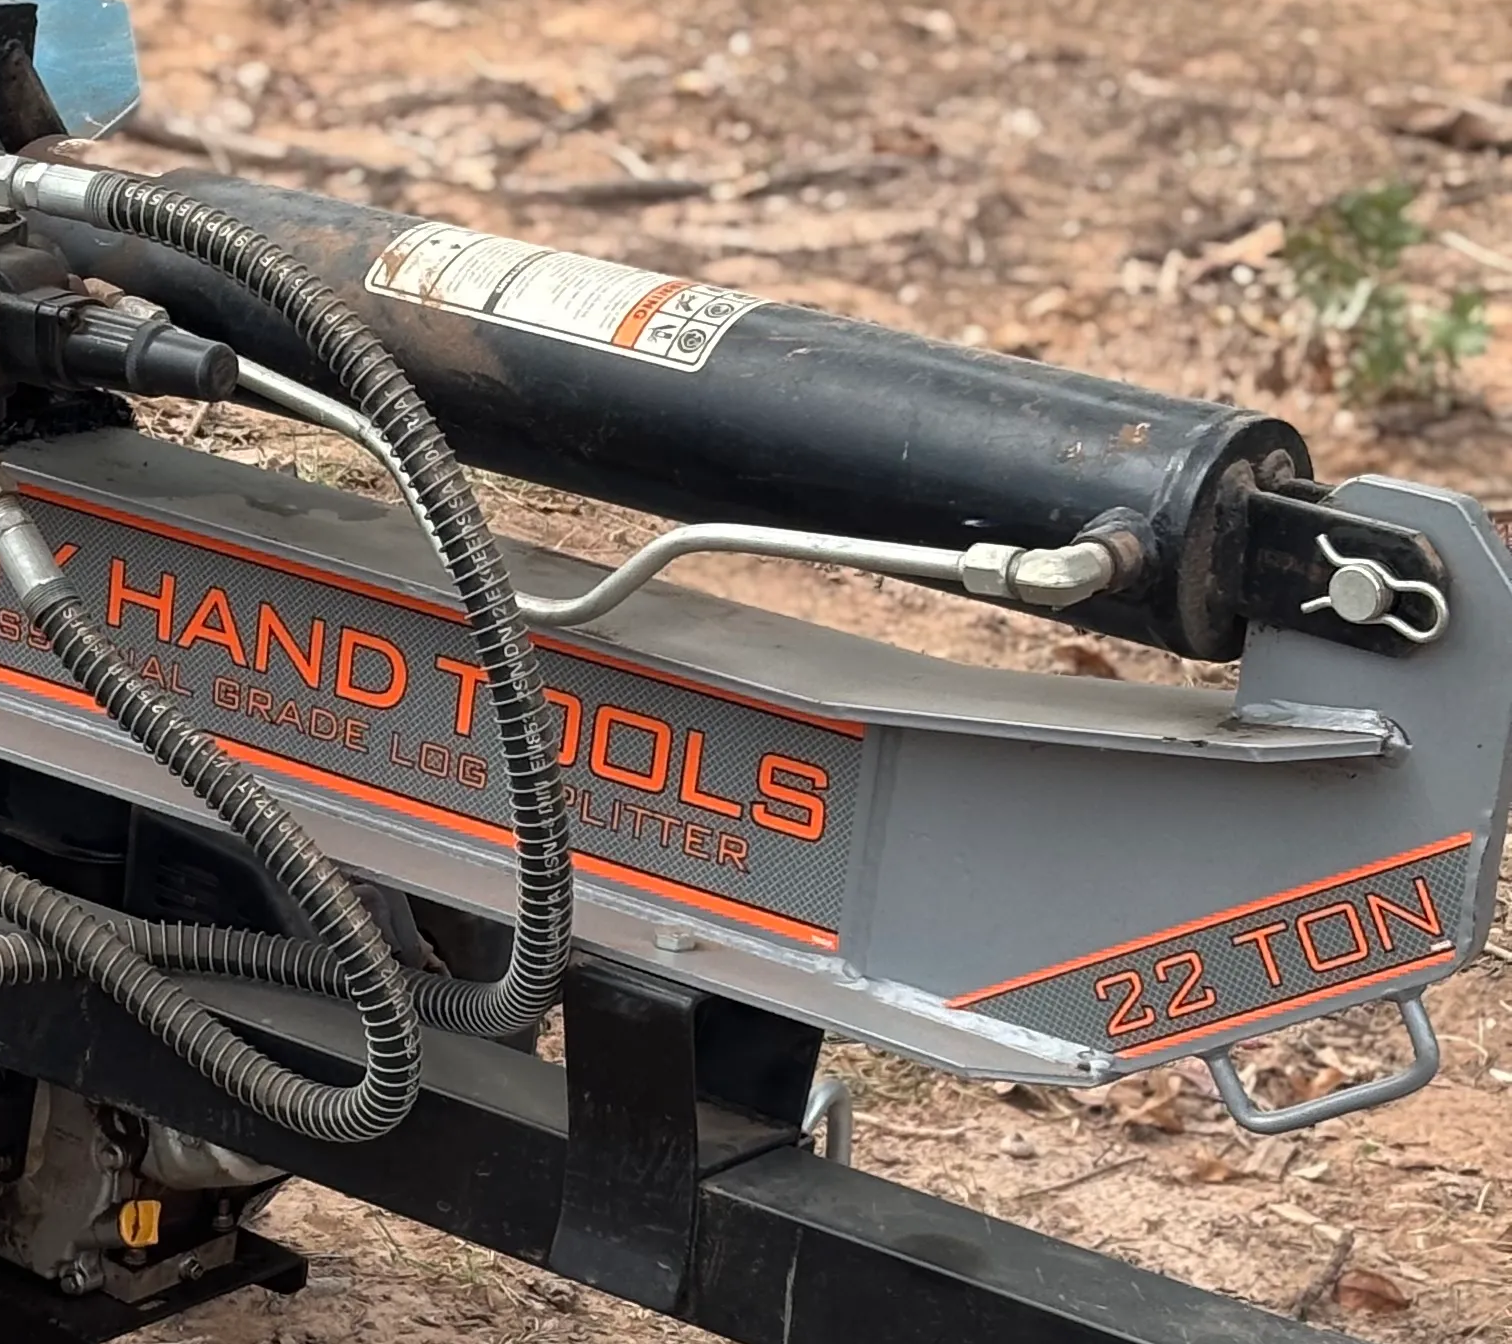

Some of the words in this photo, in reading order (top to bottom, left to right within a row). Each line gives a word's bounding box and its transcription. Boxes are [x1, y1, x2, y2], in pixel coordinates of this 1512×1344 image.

[106, 556, 409, 710] HAND
[435, 655, 830, 842] TOOLS
[213, 676, 371, 753] GRADE
[391, 733, 489, 790] LOG
[558, 784, 750, 874] PLITTER
[1094, 952, 1217, 1037] 22
[1233, 876, 1444, 988] TON
